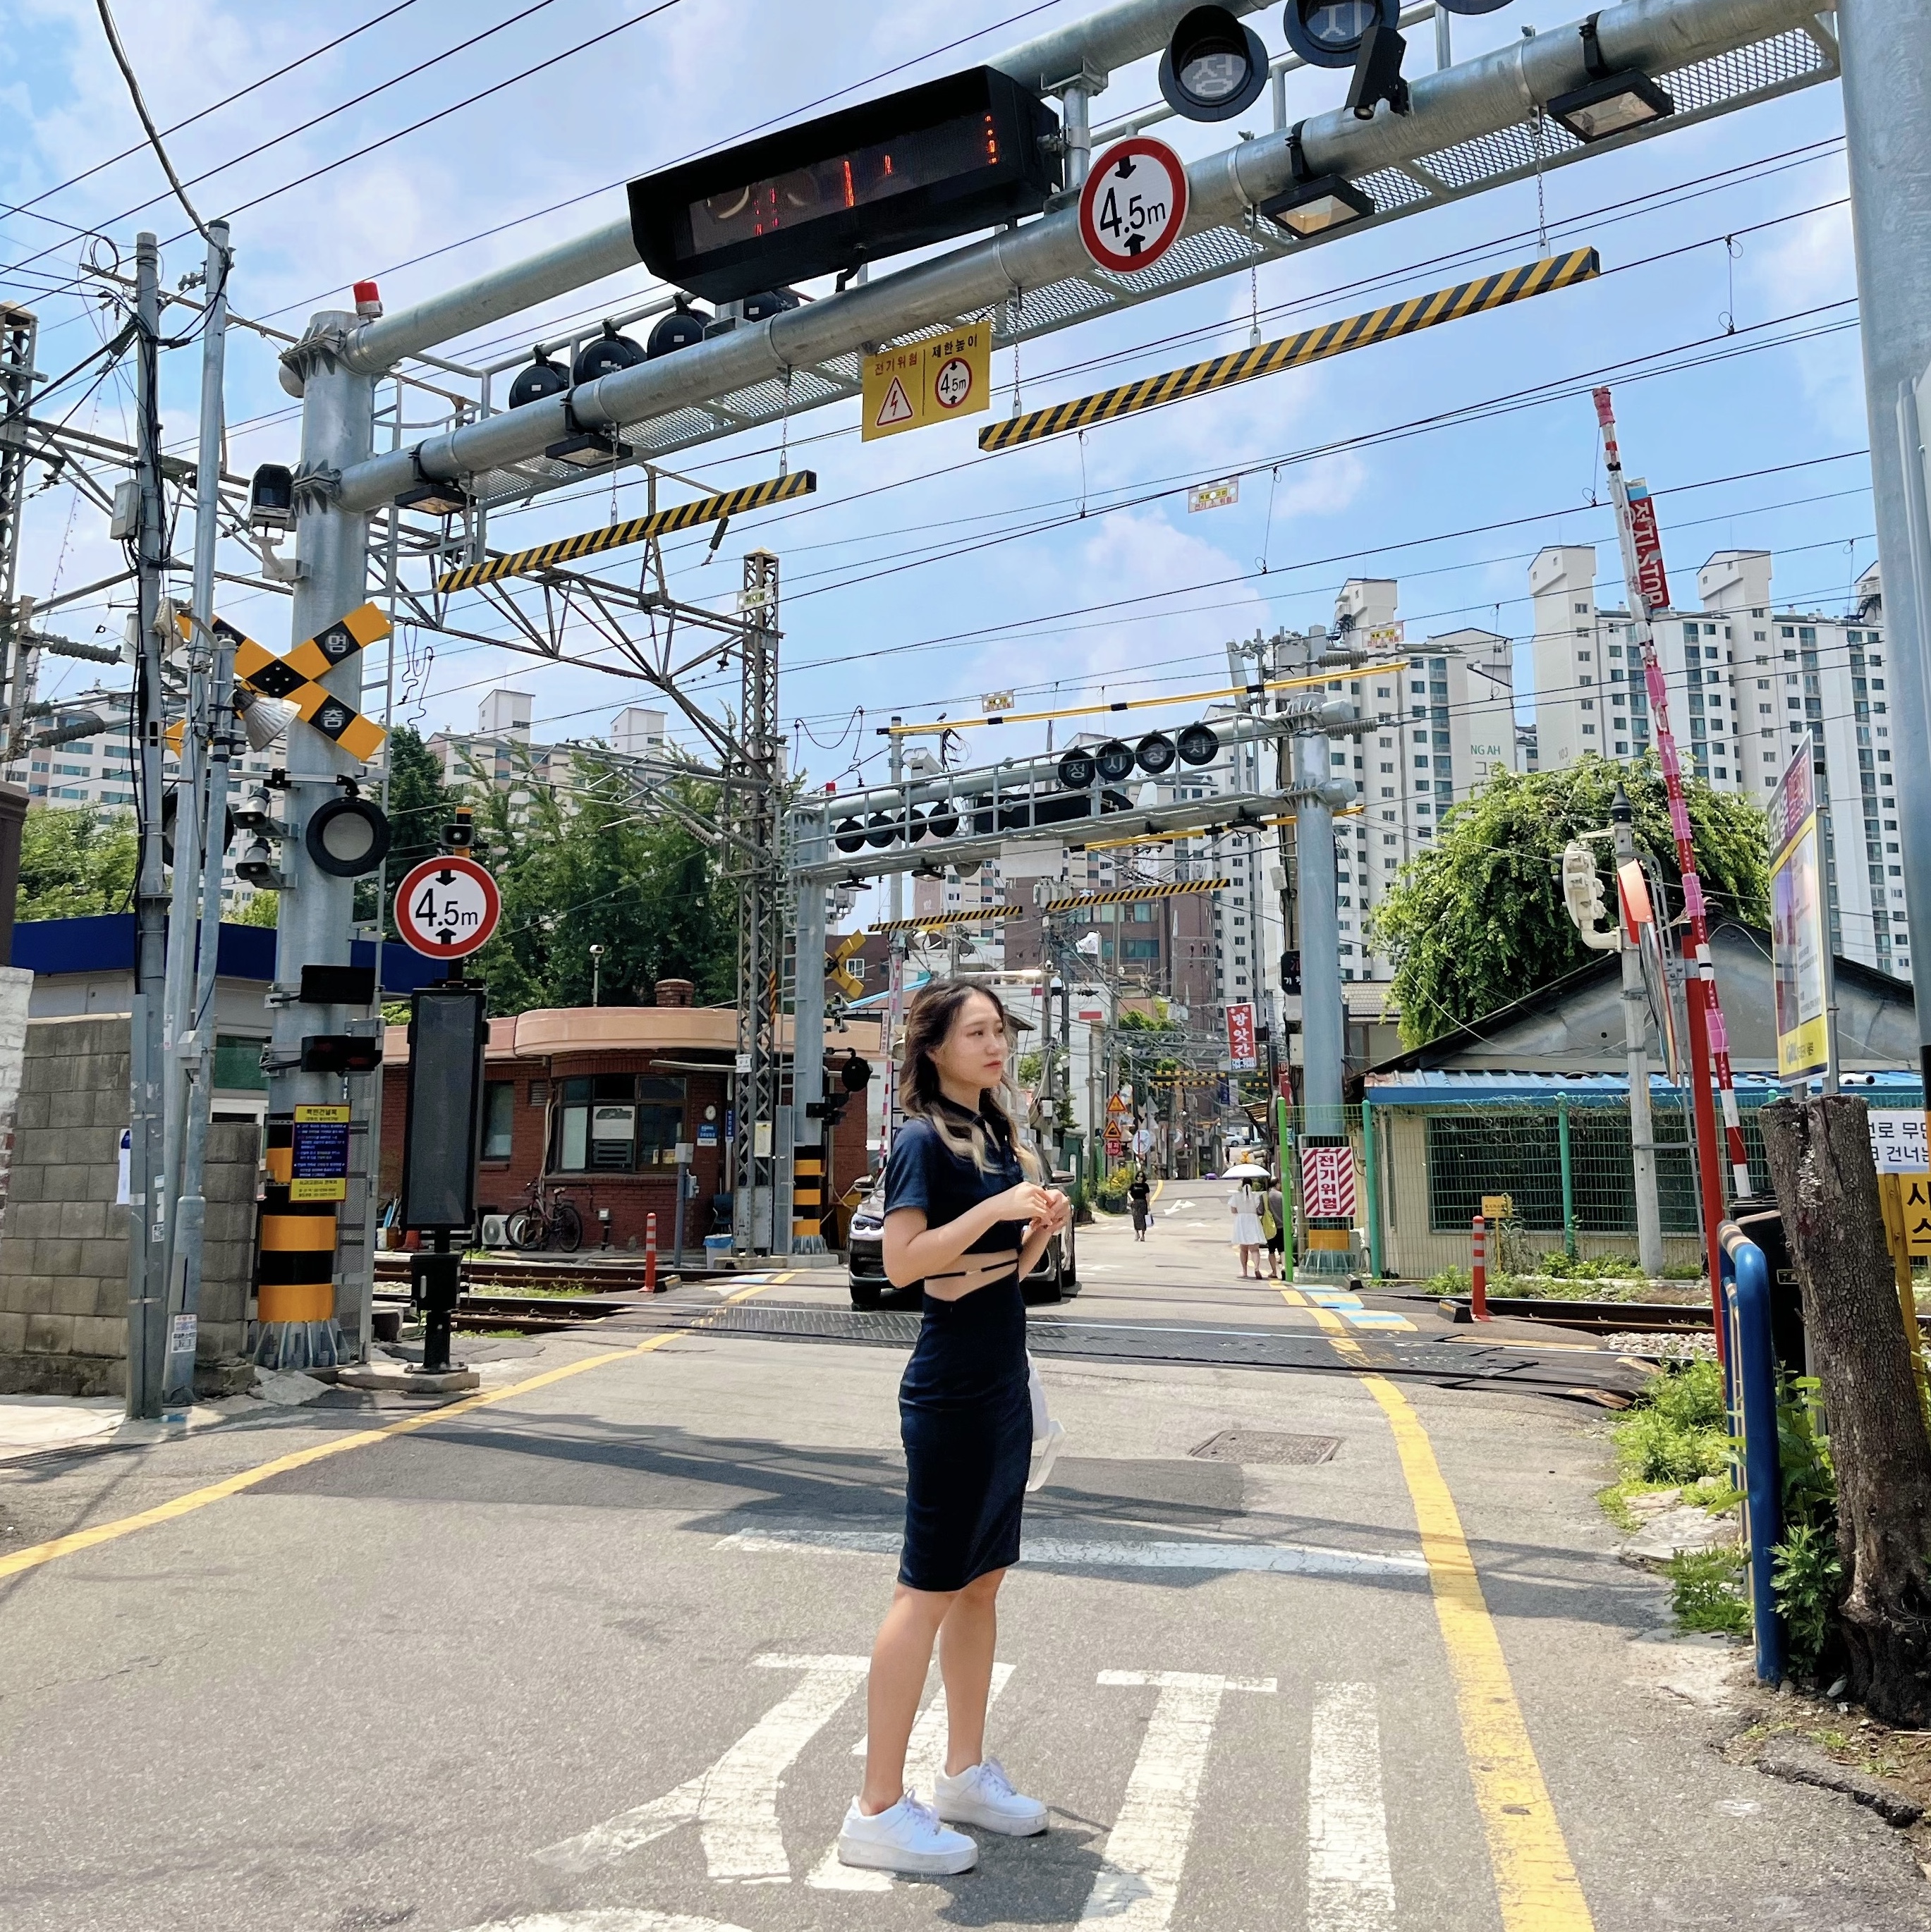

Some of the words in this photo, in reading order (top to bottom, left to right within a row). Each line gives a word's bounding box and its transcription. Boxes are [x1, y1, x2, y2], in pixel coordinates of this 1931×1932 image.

[1100, 187, 1166, 238] 4.5m
[875, 352, 918, 376] 전기위험
[932, 334, 977, 357] 제한높이
[415, 888, 478, 927] 4.5m
[1231, 1013, 1251, 1058] 방앗간
[1318, 1154, 1337, 1210] 전기위험
